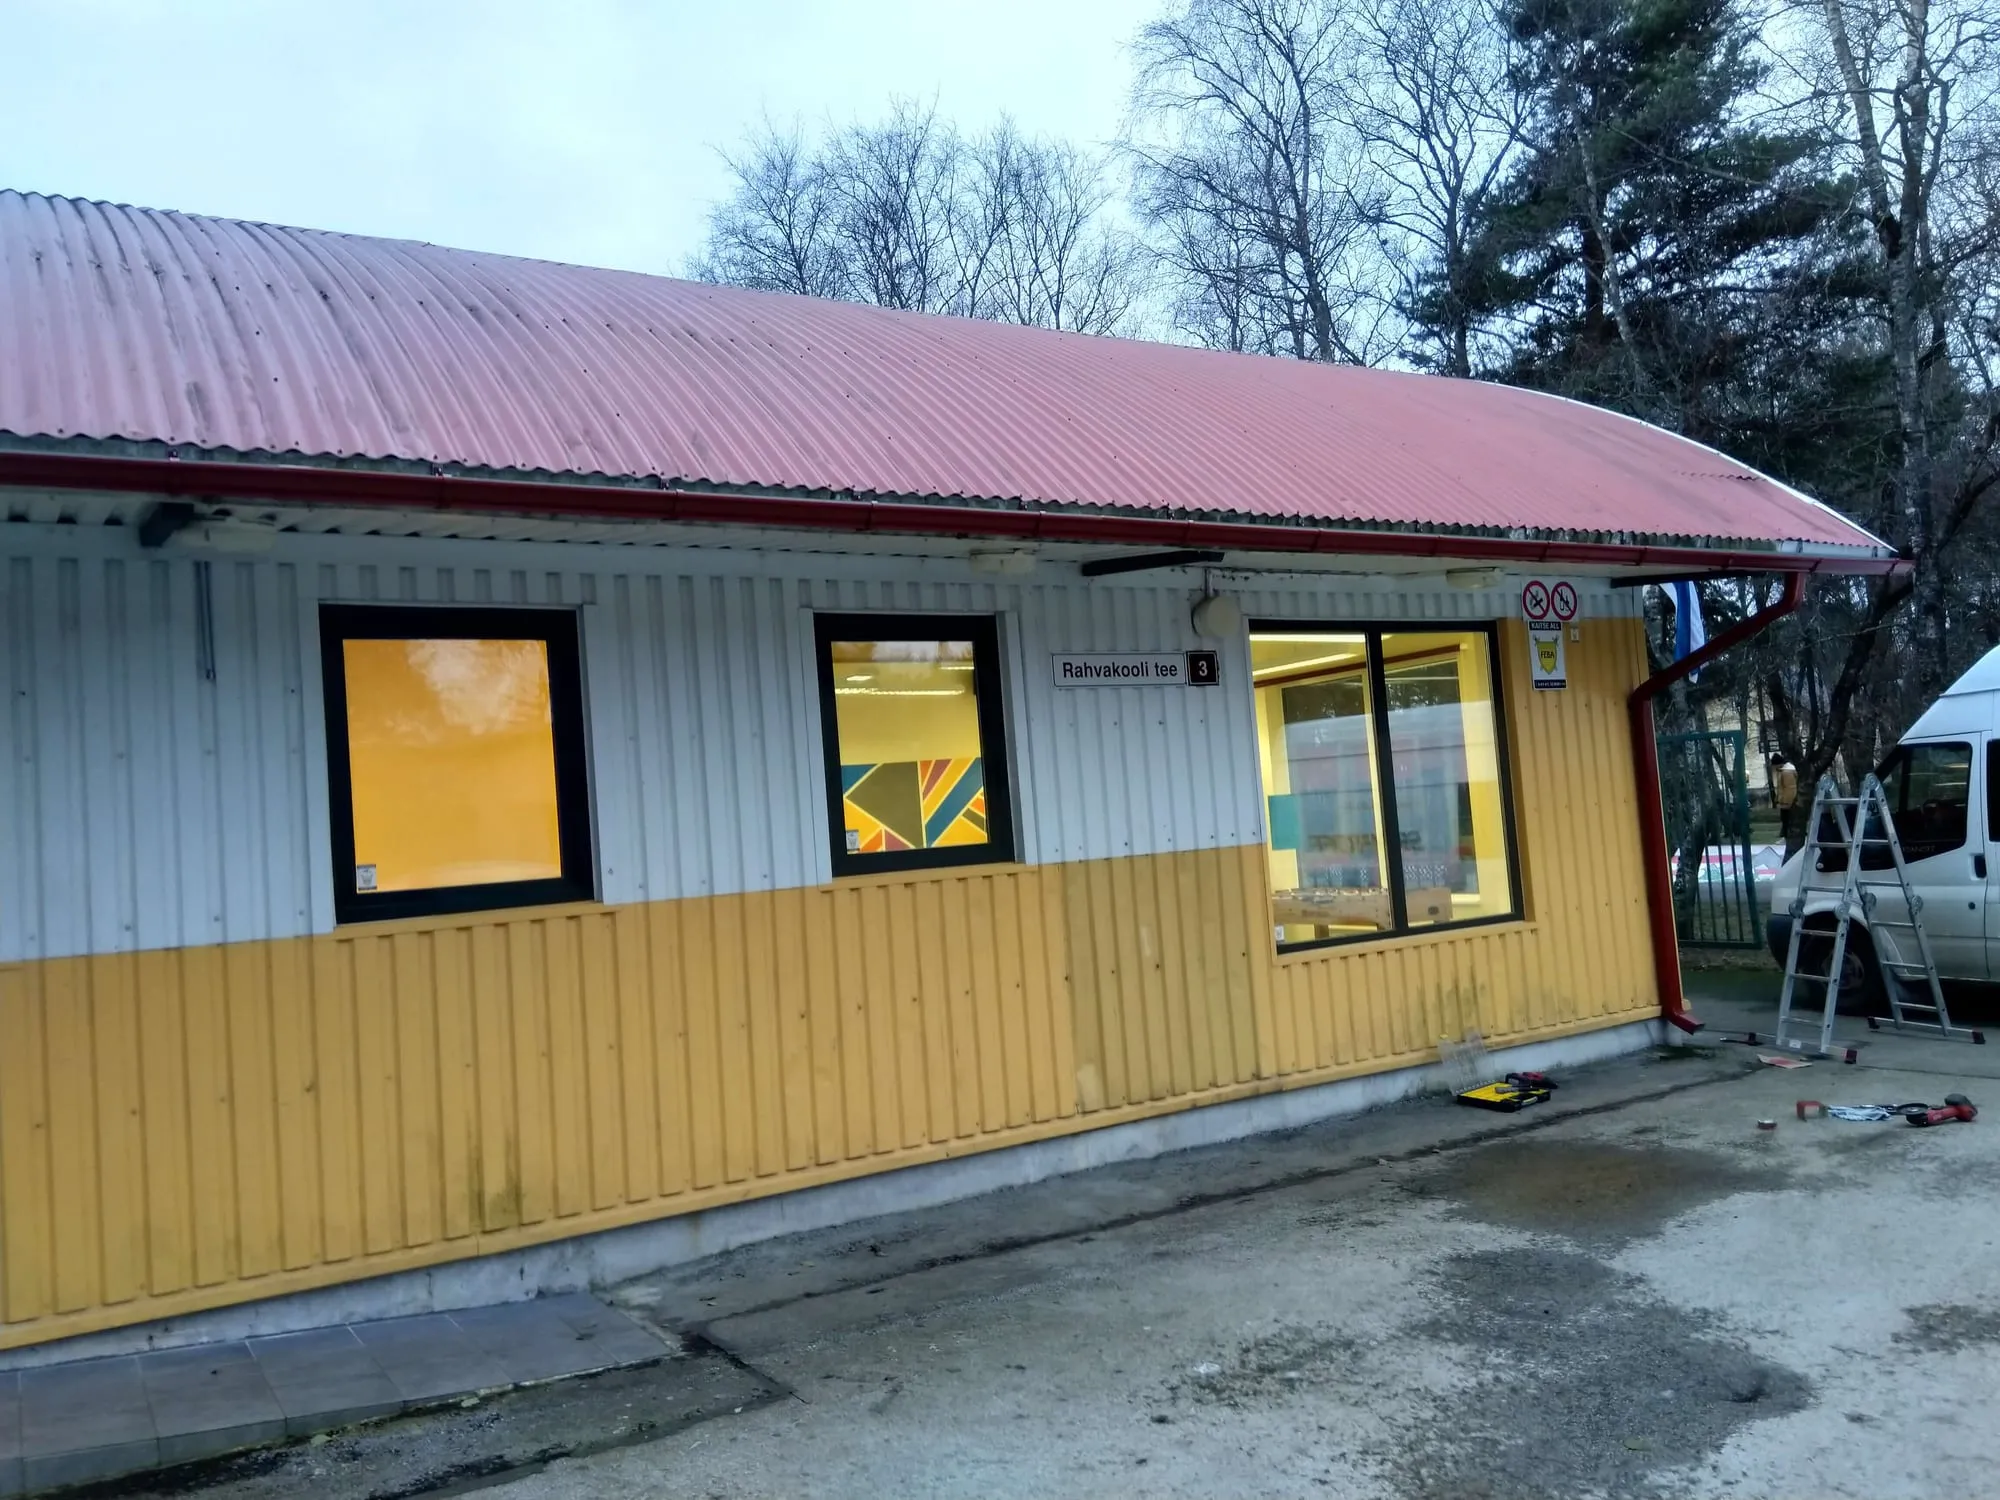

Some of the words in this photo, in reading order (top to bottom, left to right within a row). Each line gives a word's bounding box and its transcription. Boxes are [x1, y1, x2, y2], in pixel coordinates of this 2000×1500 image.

[1062, 661, 1149, 679] Rahvakooli
[1154, 662, 1178, 678] tee
[1198, 660, 1208, 677] 3
